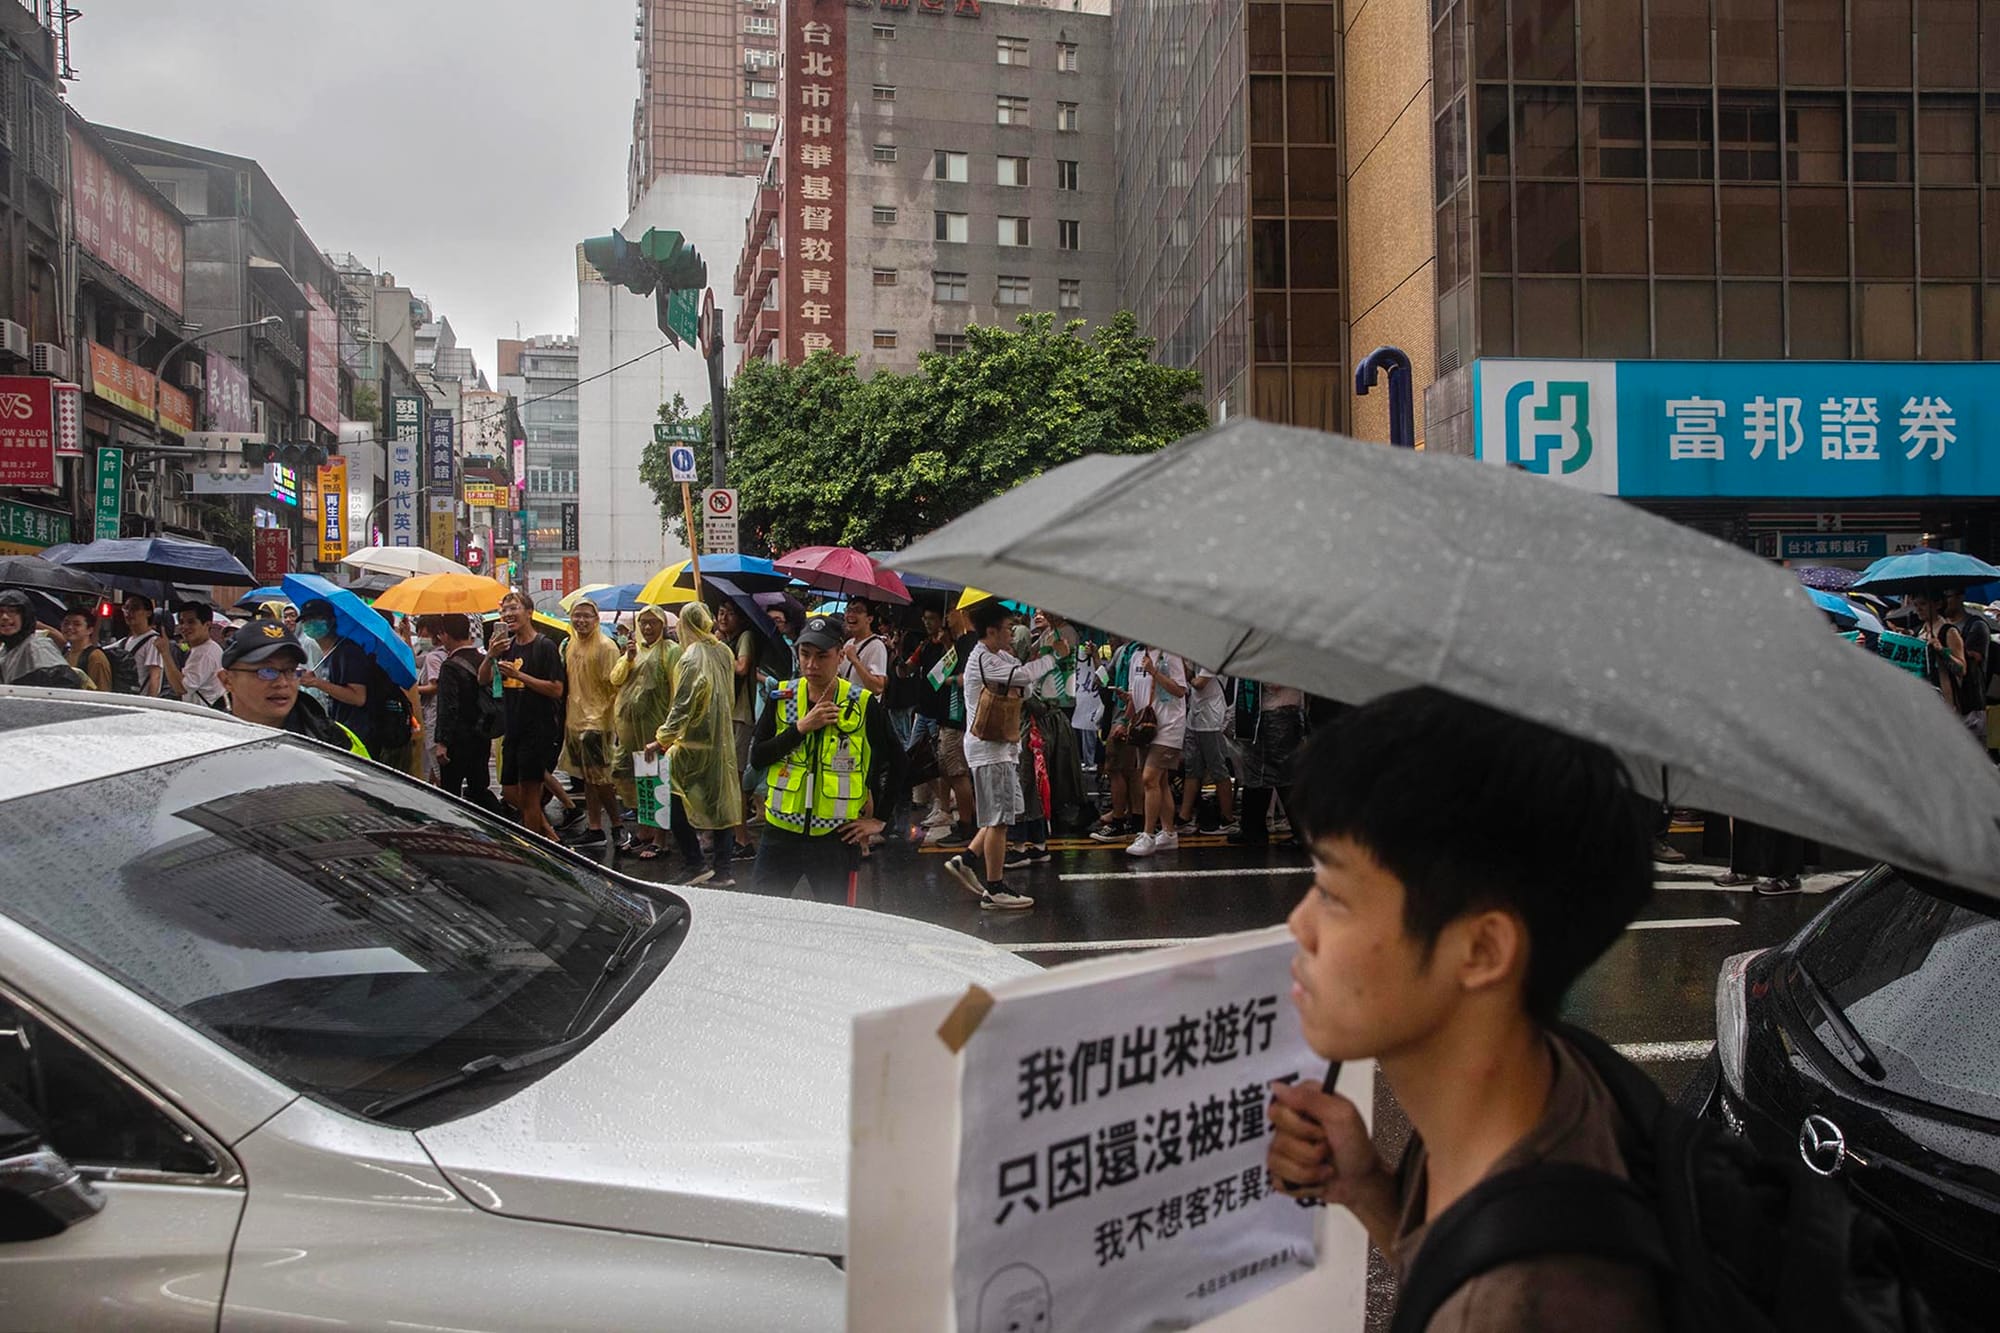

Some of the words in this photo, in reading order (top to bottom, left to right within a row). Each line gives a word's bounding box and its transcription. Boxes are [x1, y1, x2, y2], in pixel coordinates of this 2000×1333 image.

[19, 429, 48, 437] SALON
[433, 419, 450, 479] 經典美語
[1665, 395, 1957, 461] 富邦證券
[103, 461, 115, 506] 許昌街
[351, 451, 361, 480] HAIR
[327, 495, 339, 539] 再生工場
[351, 487, 362, 532] DESIGN
[1788, 540, 1868, 554] 台北富邦銀行
[1016, 994, 1279, 1120] 我們出來遊行
[995, 1071, 1300, 1225] 只因還沒被撞
[1094, 1162, 1327, 1267] 我不想客死異
